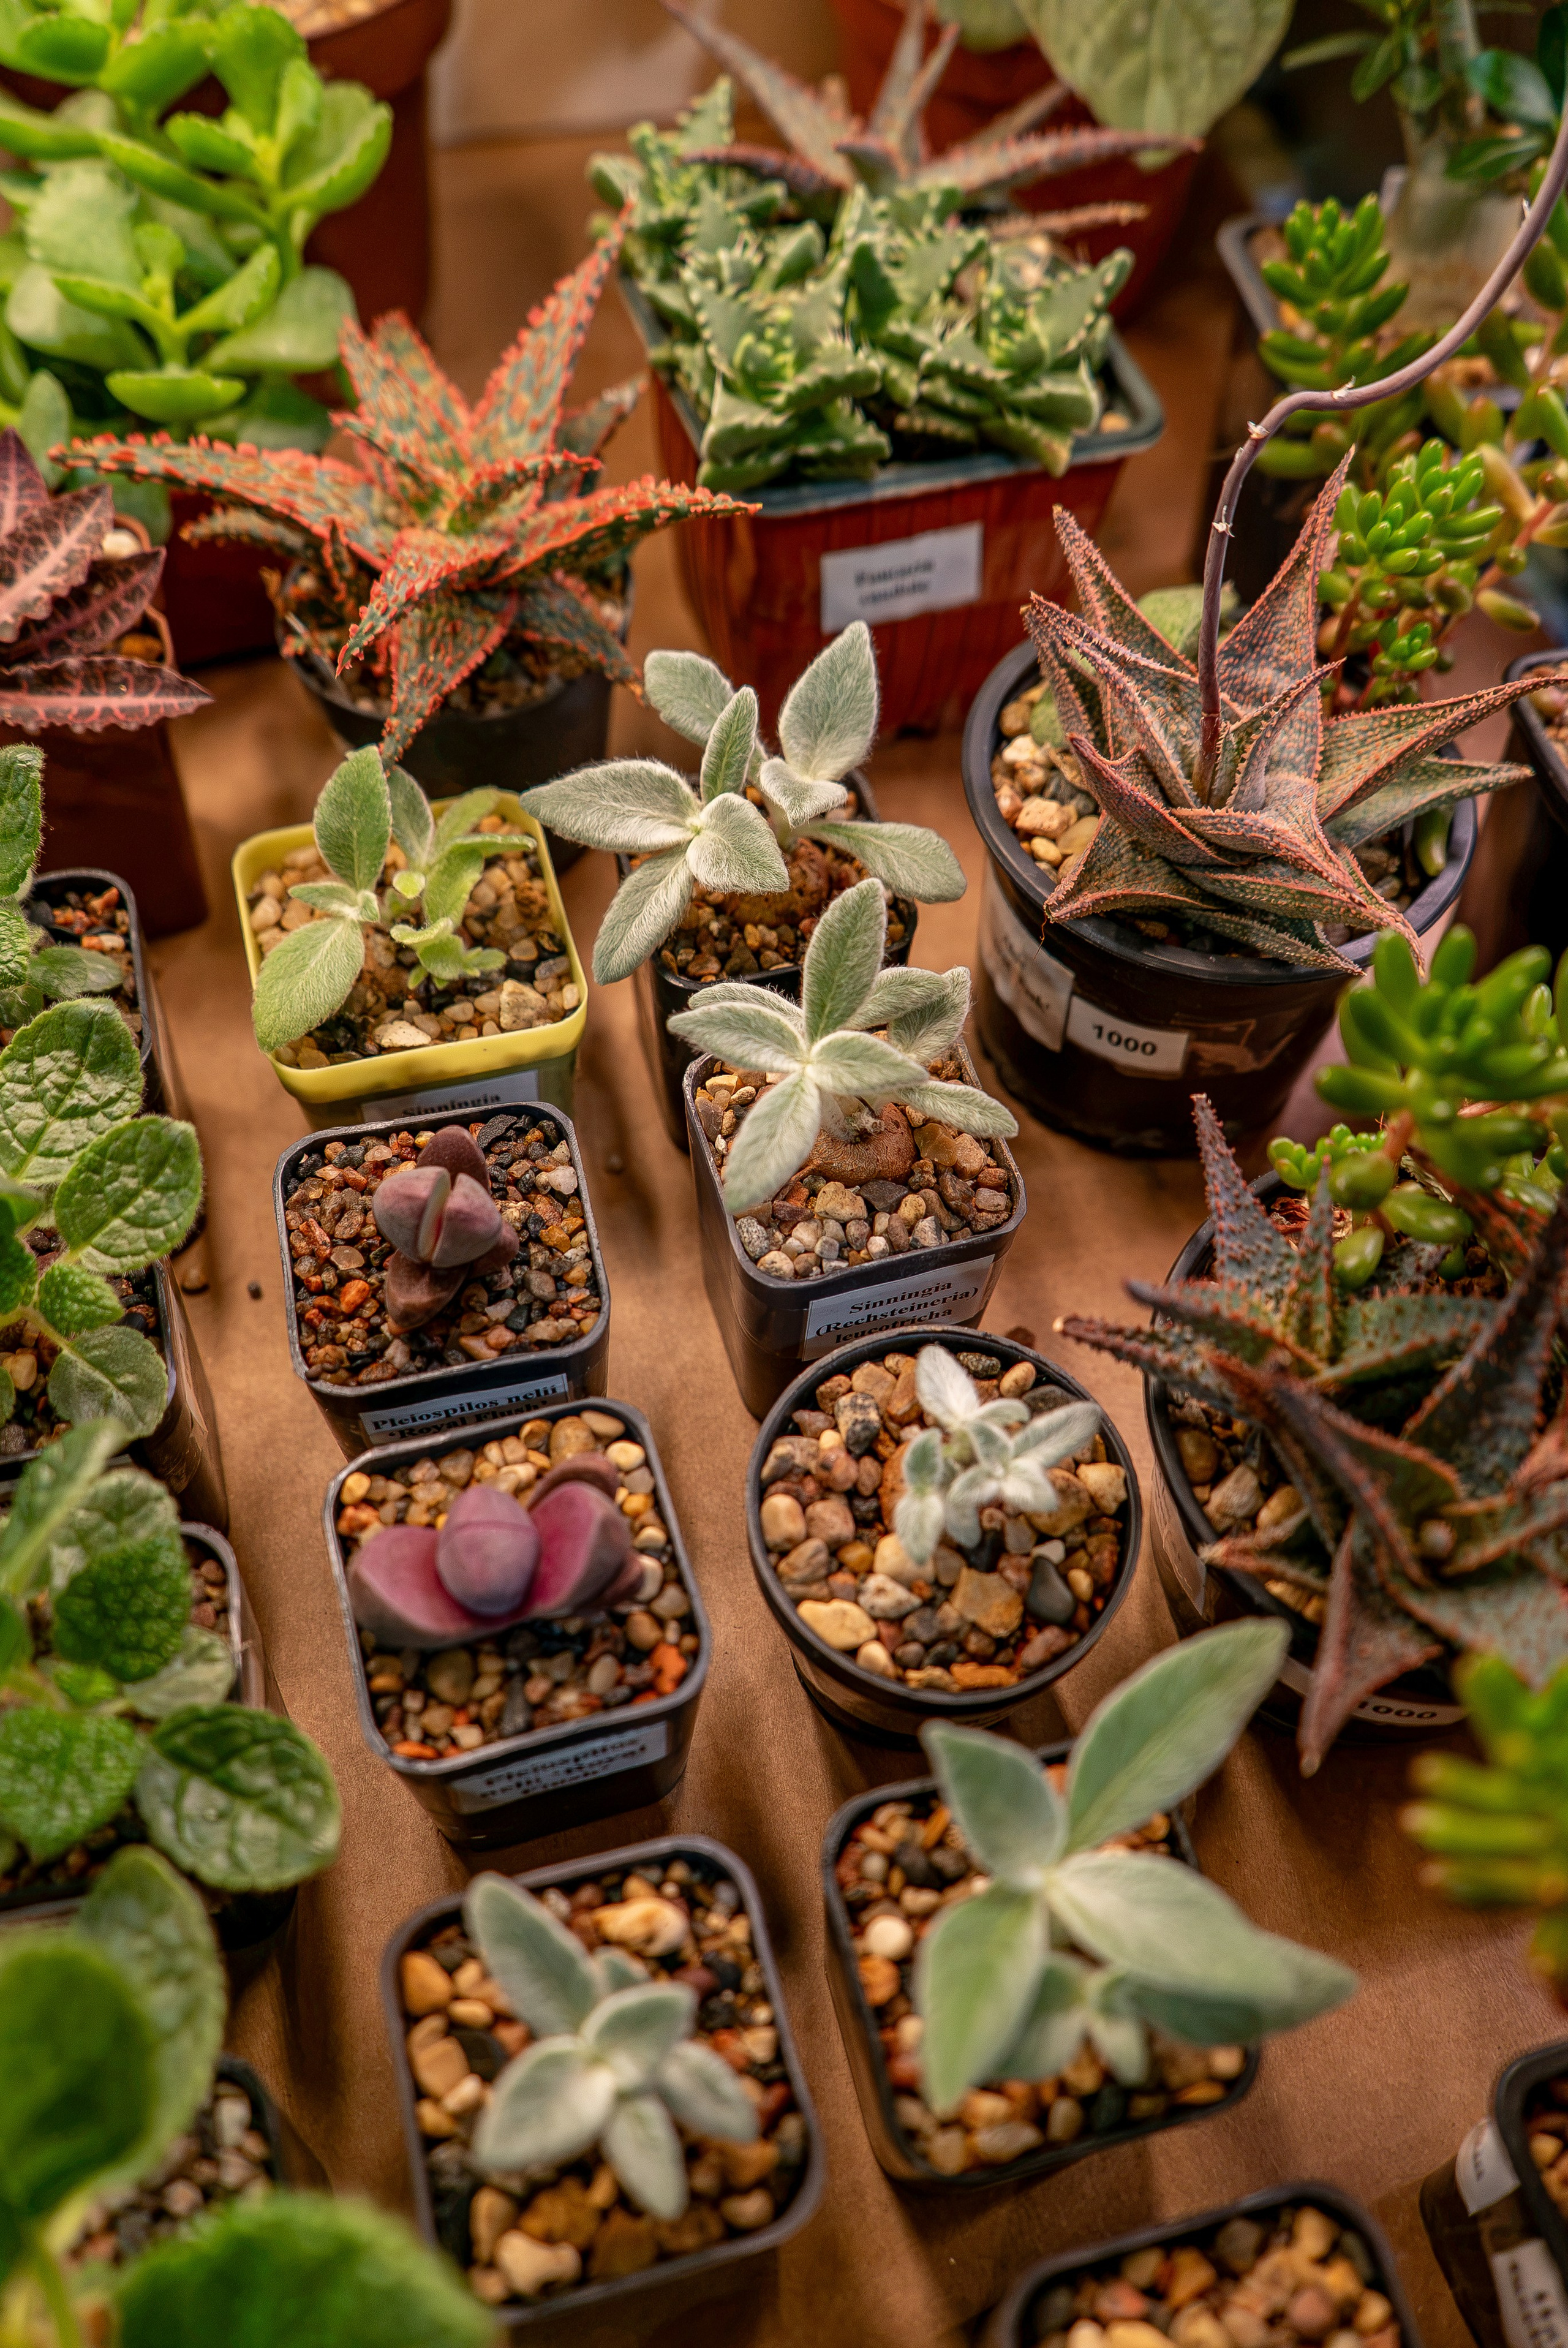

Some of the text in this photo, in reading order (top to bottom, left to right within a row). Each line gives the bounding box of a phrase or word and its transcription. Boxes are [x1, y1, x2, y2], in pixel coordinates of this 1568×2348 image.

[1092, 1024, 1156, 1055] 1000
[815, 1287, 979, 1337] (Rechsteineria)
[849, 1282, 952, 1315] Sinningia
[835, 1308, 952, 1344] leucotricha
[373, 1384, 557, 1430] Pleiospilos nelii
